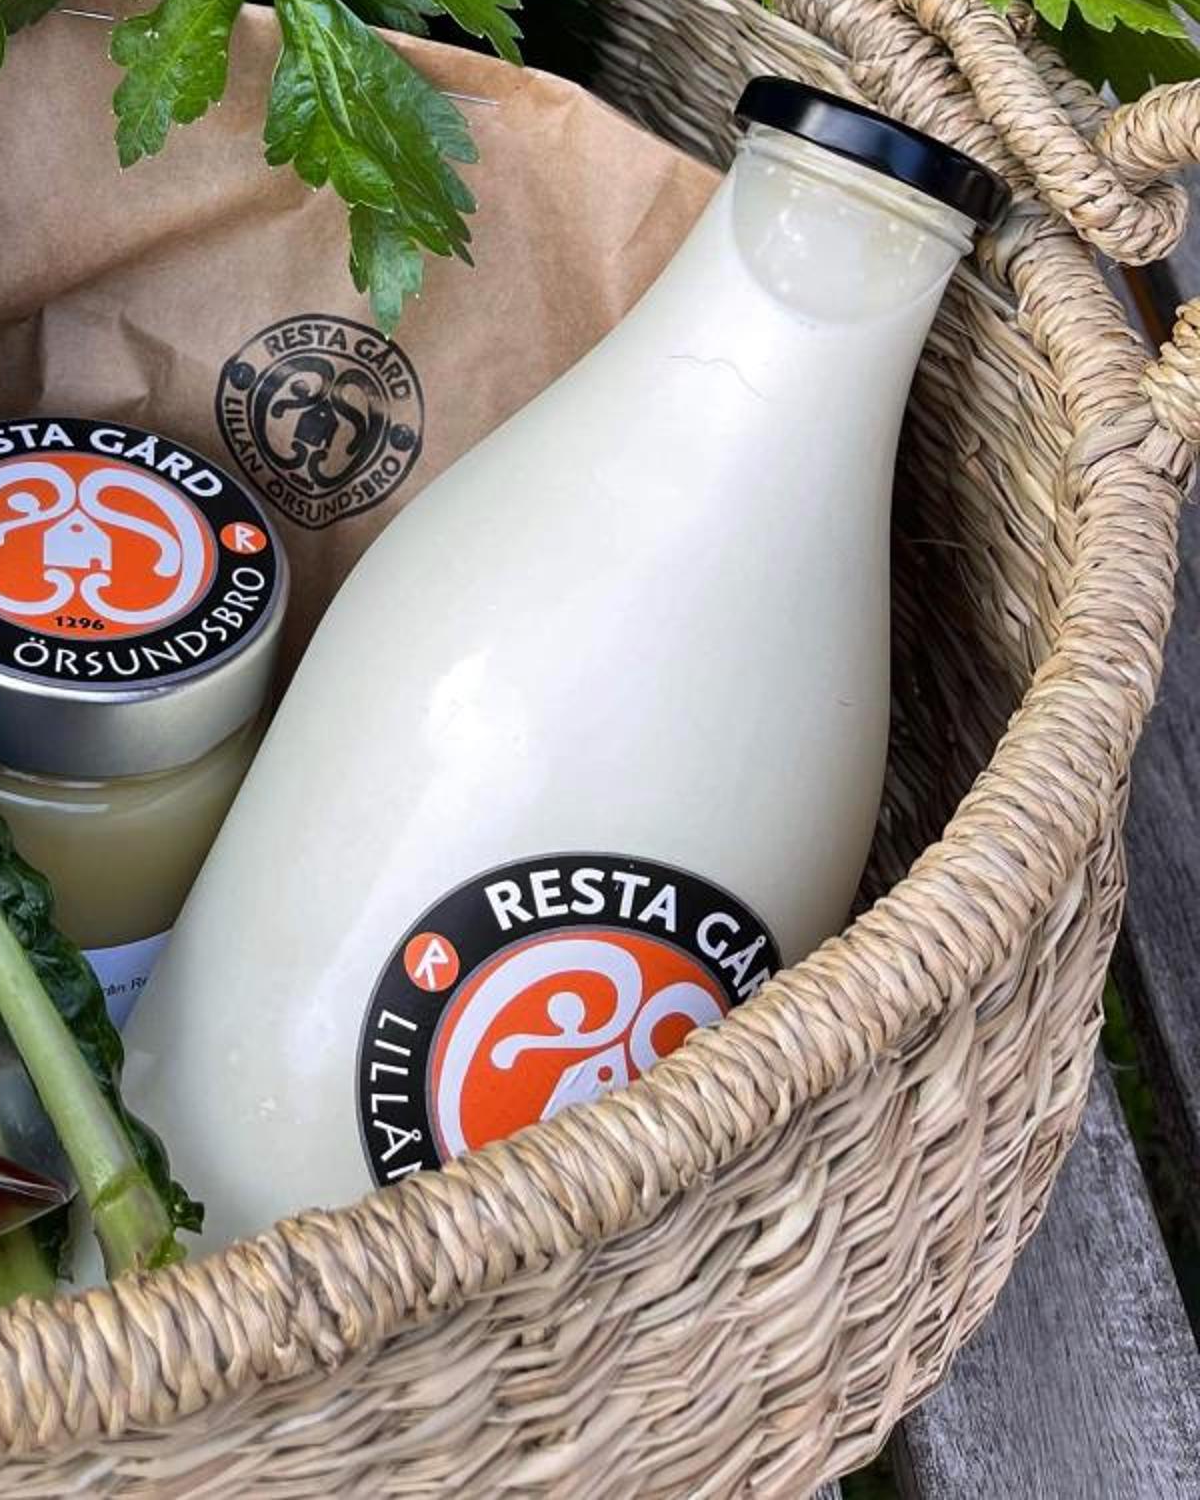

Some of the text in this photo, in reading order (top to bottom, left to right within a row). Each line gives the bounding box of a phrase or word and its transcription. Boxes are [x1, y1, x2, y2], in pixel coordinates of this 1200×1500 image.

[262, 323, 412, 401] RESTA GÅRD
[88, 428, 224, 500] GÅRD
[224, 396, 401, 523] LILLÅN ÖRSUNDSBRO
[13, 566, 266, 677] ÖRSUNDSBRO
[53, 615, 106, 632] 1296
[484, 867, 767, 998] RESTA GÅ
